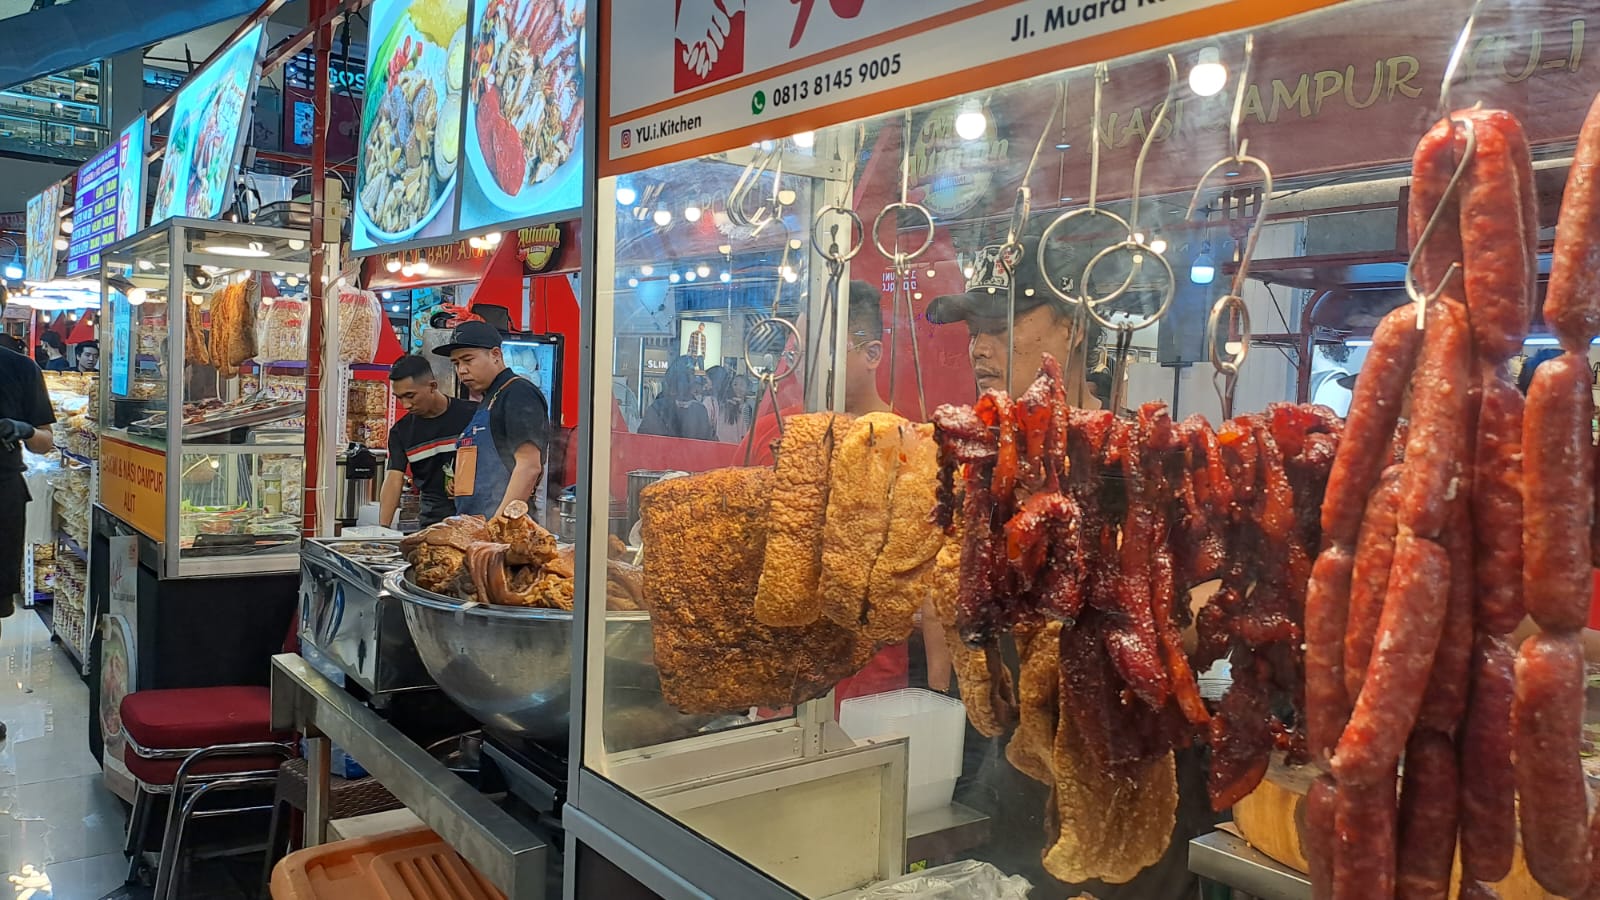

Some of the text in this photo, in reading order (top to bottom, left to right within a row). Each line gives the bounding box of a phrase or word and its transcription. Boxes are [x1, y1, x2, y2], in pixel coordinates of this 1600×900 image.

[1011, 0, 1126, 41] Jl. Muara
[773, 53, 901, 107] 0813 8145 9005
[1088, 99, 1185, 151] NASI
[1206, 55, 1423, 133] AMPUR
[635, 115, 702, 144] YU.i.Kitchen
[647, 360, 669, 369] SLIM
[137, 464, 164, 495] CAMPUR
